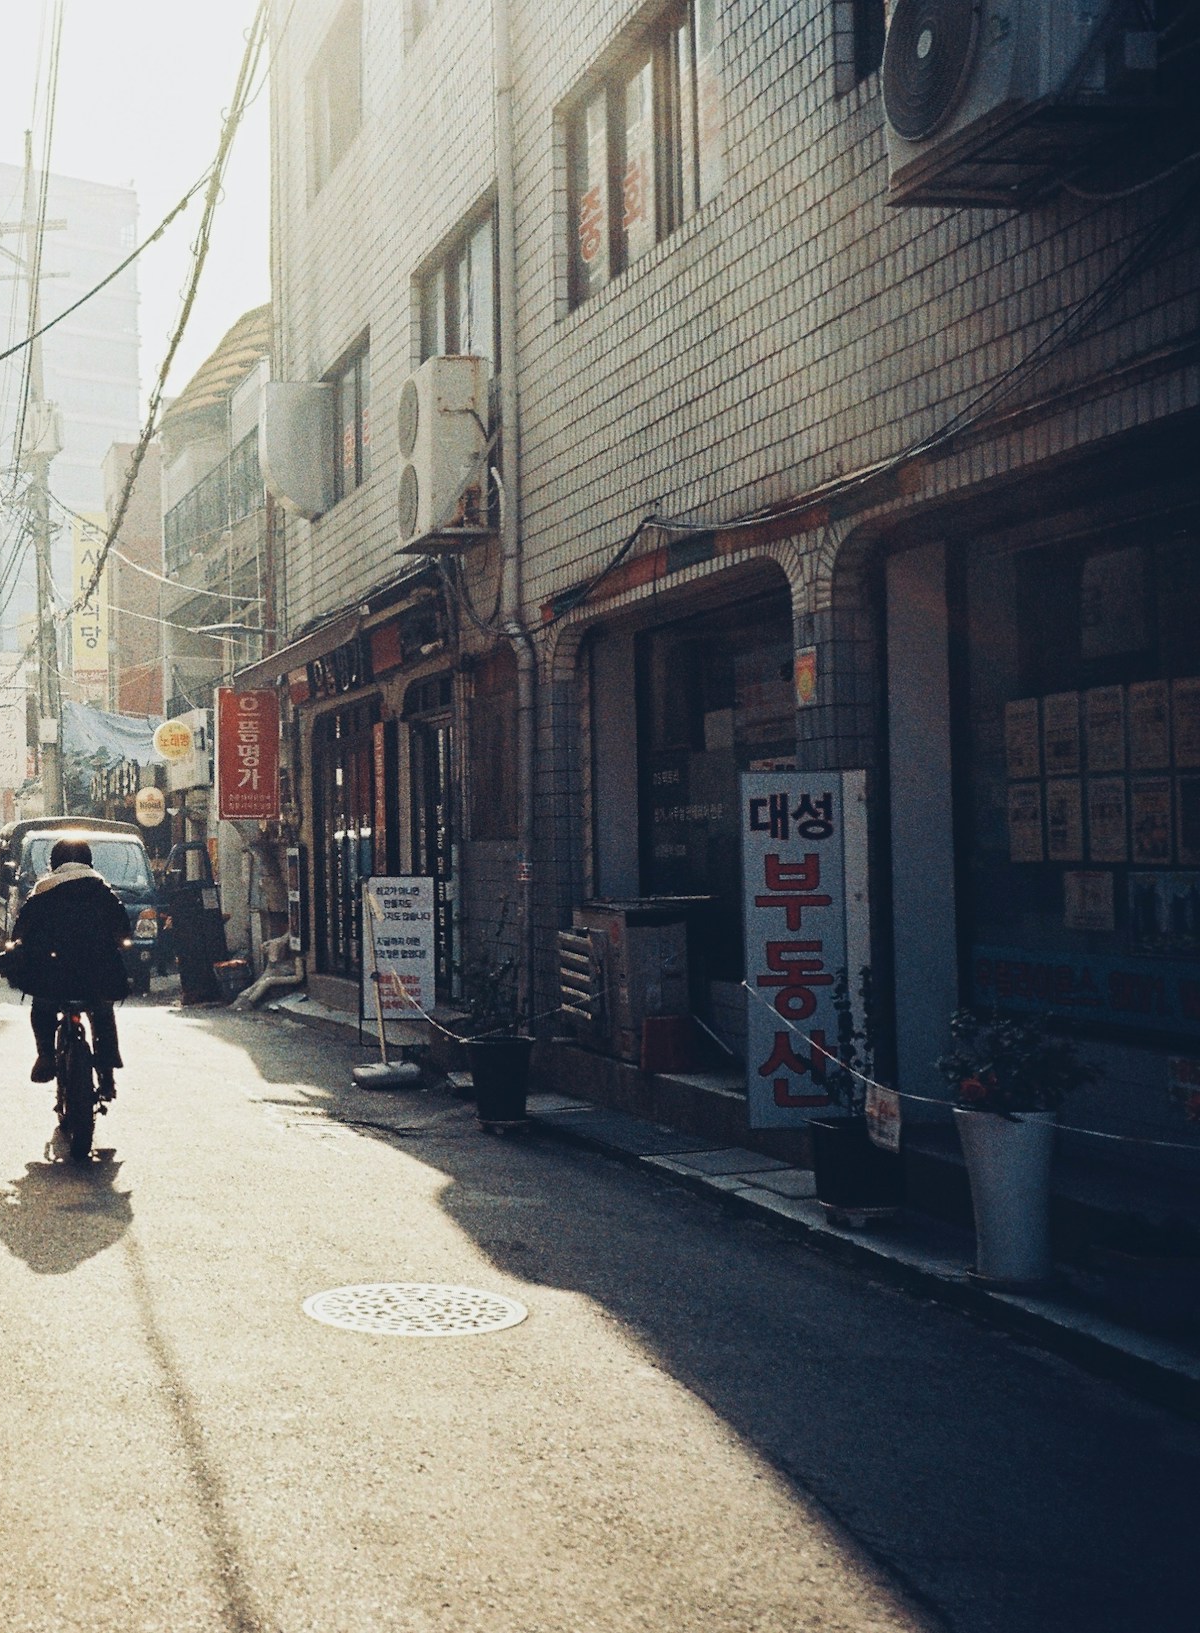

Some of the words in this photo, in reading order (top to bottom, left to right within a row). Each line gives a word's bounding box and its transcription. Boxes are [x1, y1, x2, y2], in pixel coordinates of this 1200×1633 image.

[236, 696, 262, 790] 으뜸명가
[748, 793, 835, 841] 대성
[754, 853, 839, 1108] 부동산
